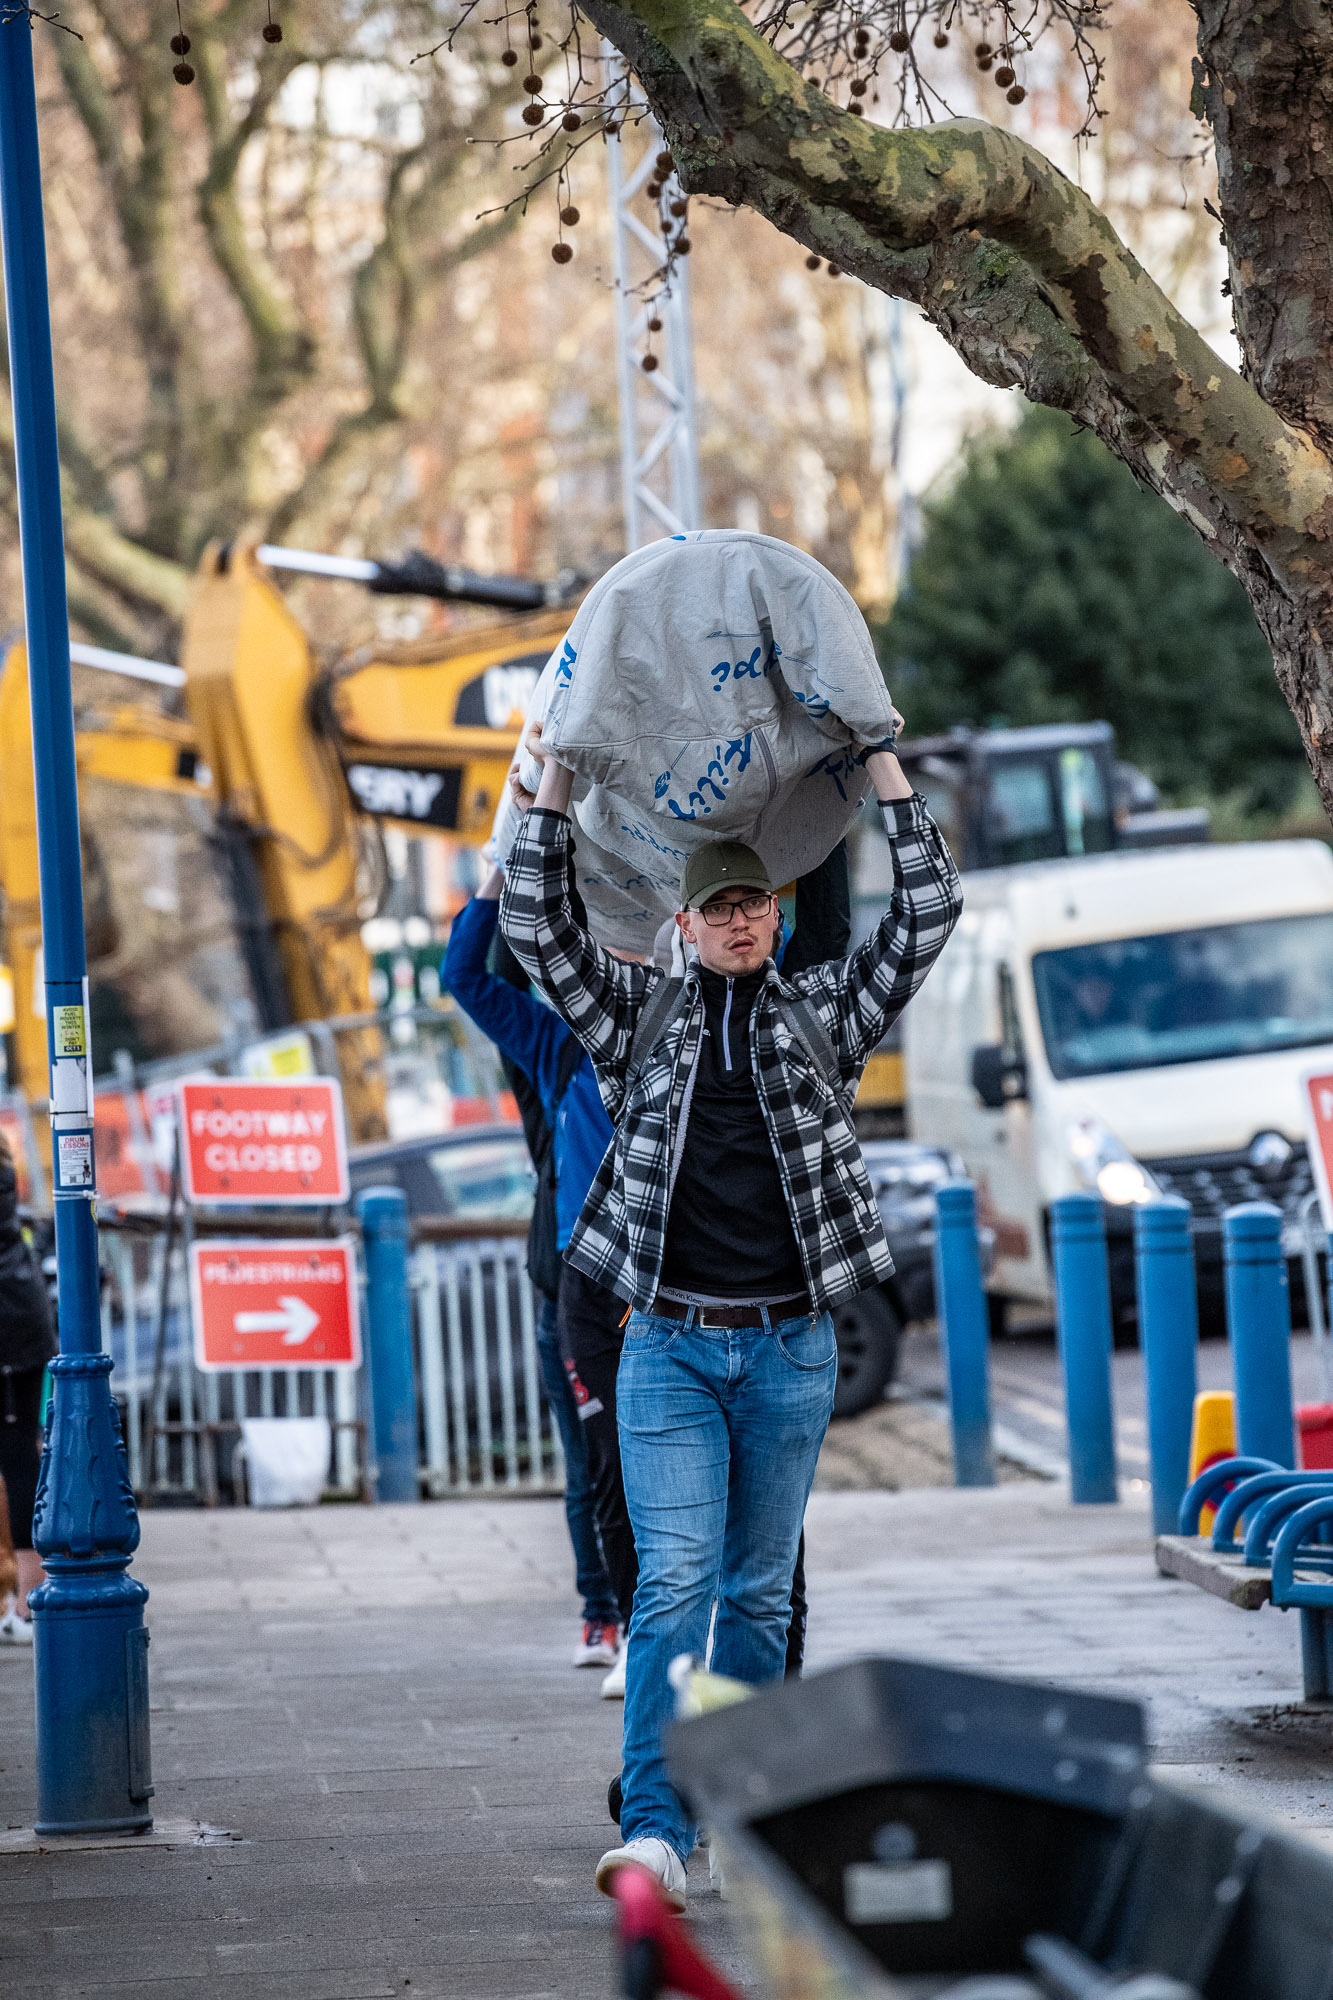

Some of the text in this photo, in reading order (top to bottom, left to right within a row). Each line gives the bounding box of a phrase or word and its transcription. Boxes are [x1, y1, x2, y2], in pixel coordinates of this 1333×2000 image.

[191, 1110, 327, 1138] FOOTWAY
[204, 1144, 323, 1172] CLOSED
[661, 1286, 704, 1306] Calvin Klein
